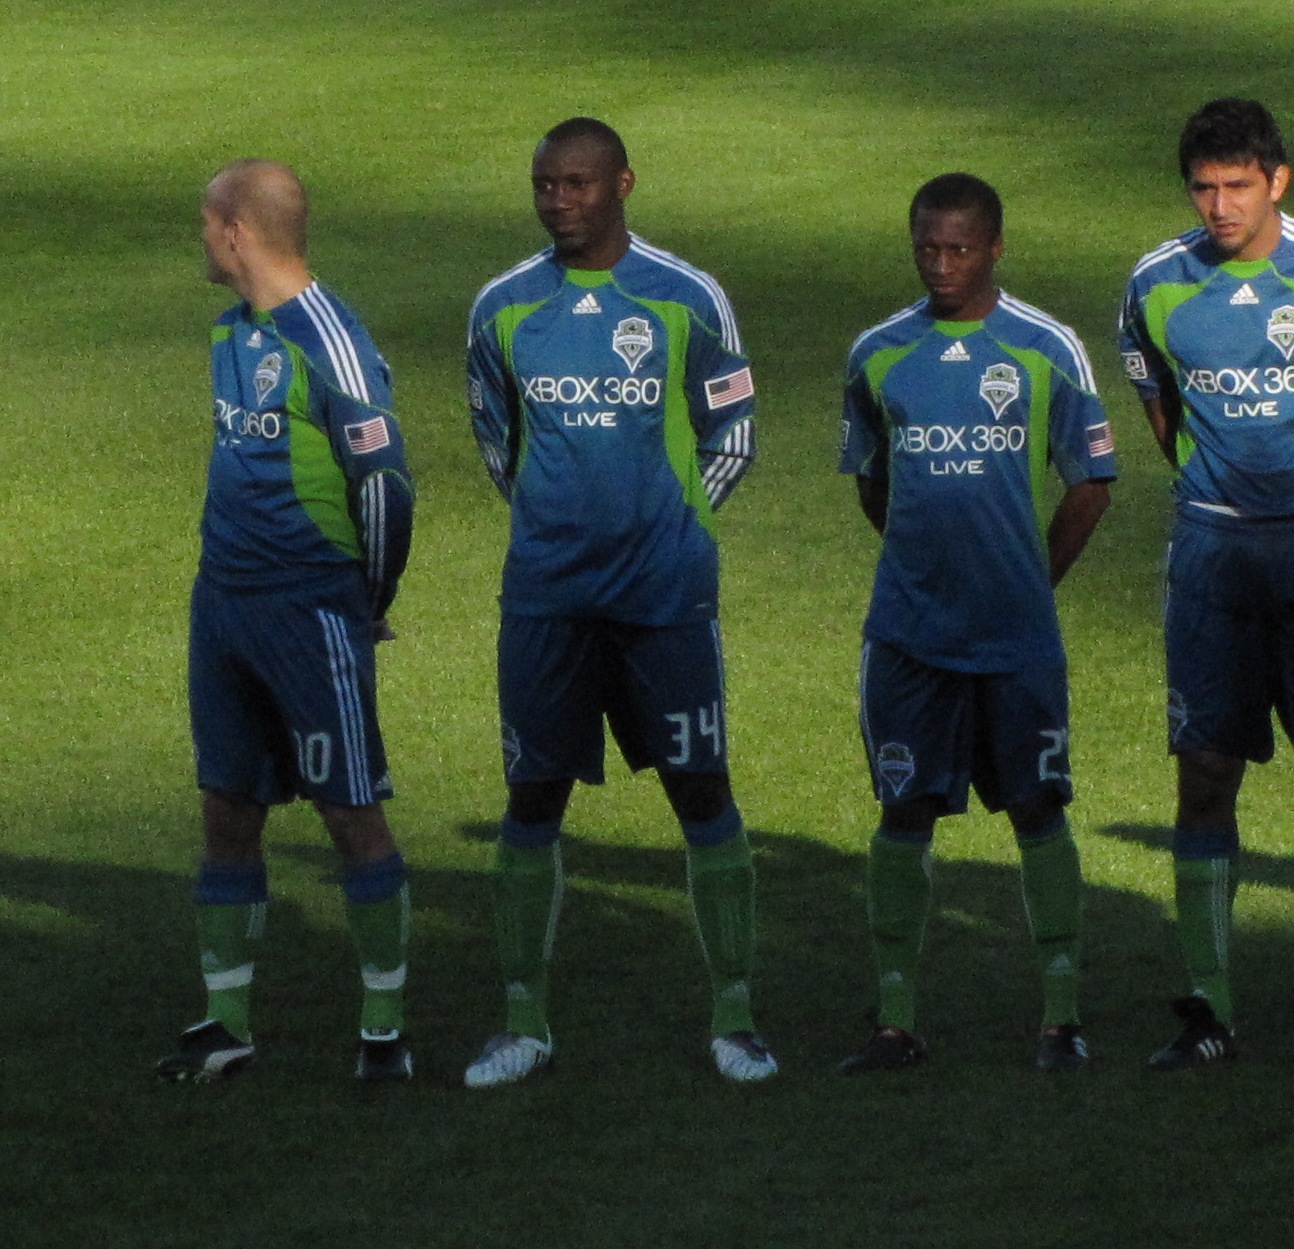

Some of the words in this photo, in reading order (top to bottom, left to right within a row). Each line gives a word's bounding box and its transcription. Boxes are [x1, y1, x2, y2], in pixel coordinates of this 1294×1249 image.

[520, 375, 600, 404] XBOX
[604, 376, 660, 405] 360
[1181, 367, 1261, 396] XBOX
[563, 411, 617, 427] LIVE
[1223, 400, 1279, 418] LIVE
[894, 424, 967, 453] XBOX
[971, 424, 1024, 452] 360
[929, 459, 985, 475] LIVE
[664, 701, 720, 766] 34
